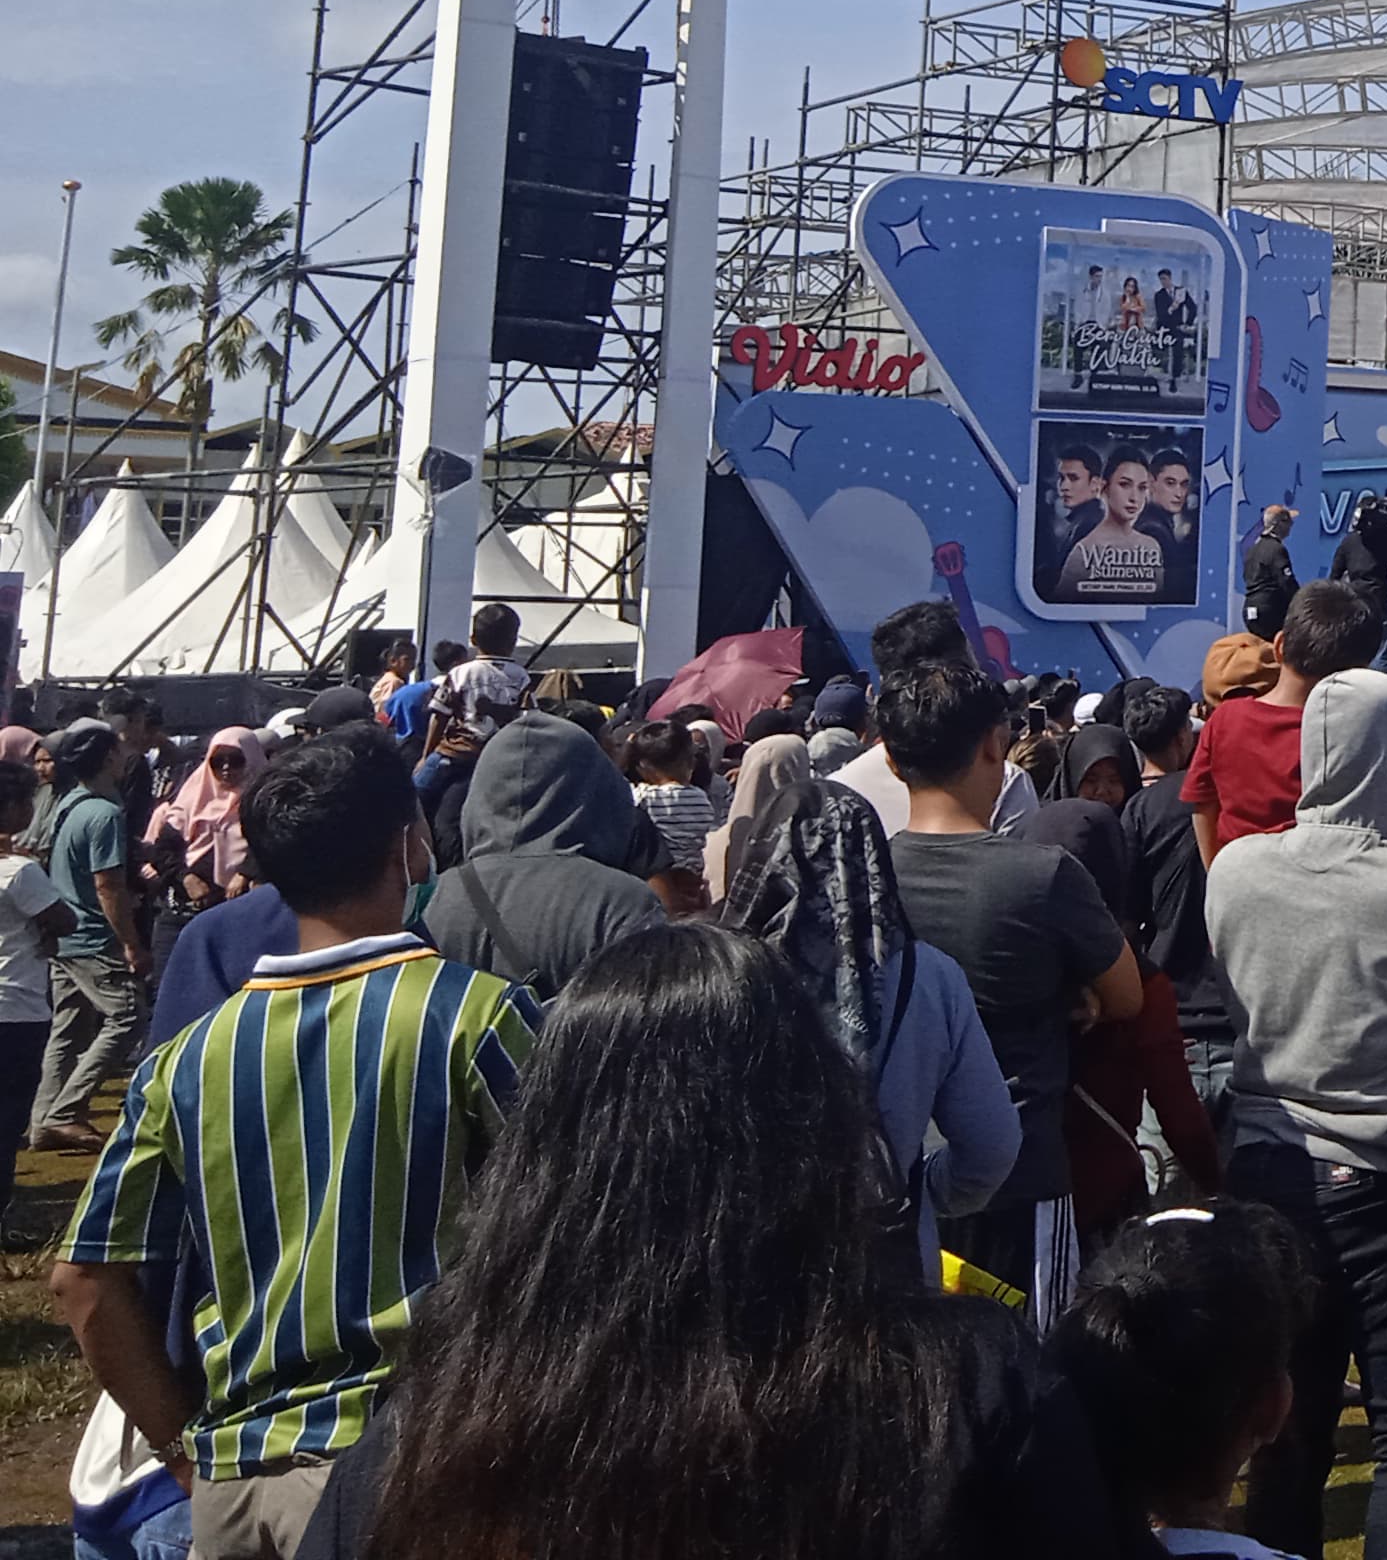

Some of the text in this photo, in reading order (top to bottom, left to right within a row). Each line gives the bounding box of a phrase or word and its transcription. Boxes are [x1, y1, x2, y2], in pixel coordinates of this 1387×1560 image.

[1103, 67, 1244, 124] SCTV
[731, 323, 926, 392] Vidio
[1089, 344, 1161, 371] Waktu
[1080, 543, 1162, 569] Wanita
[1088, 564, 1155, 580] Istimewa
